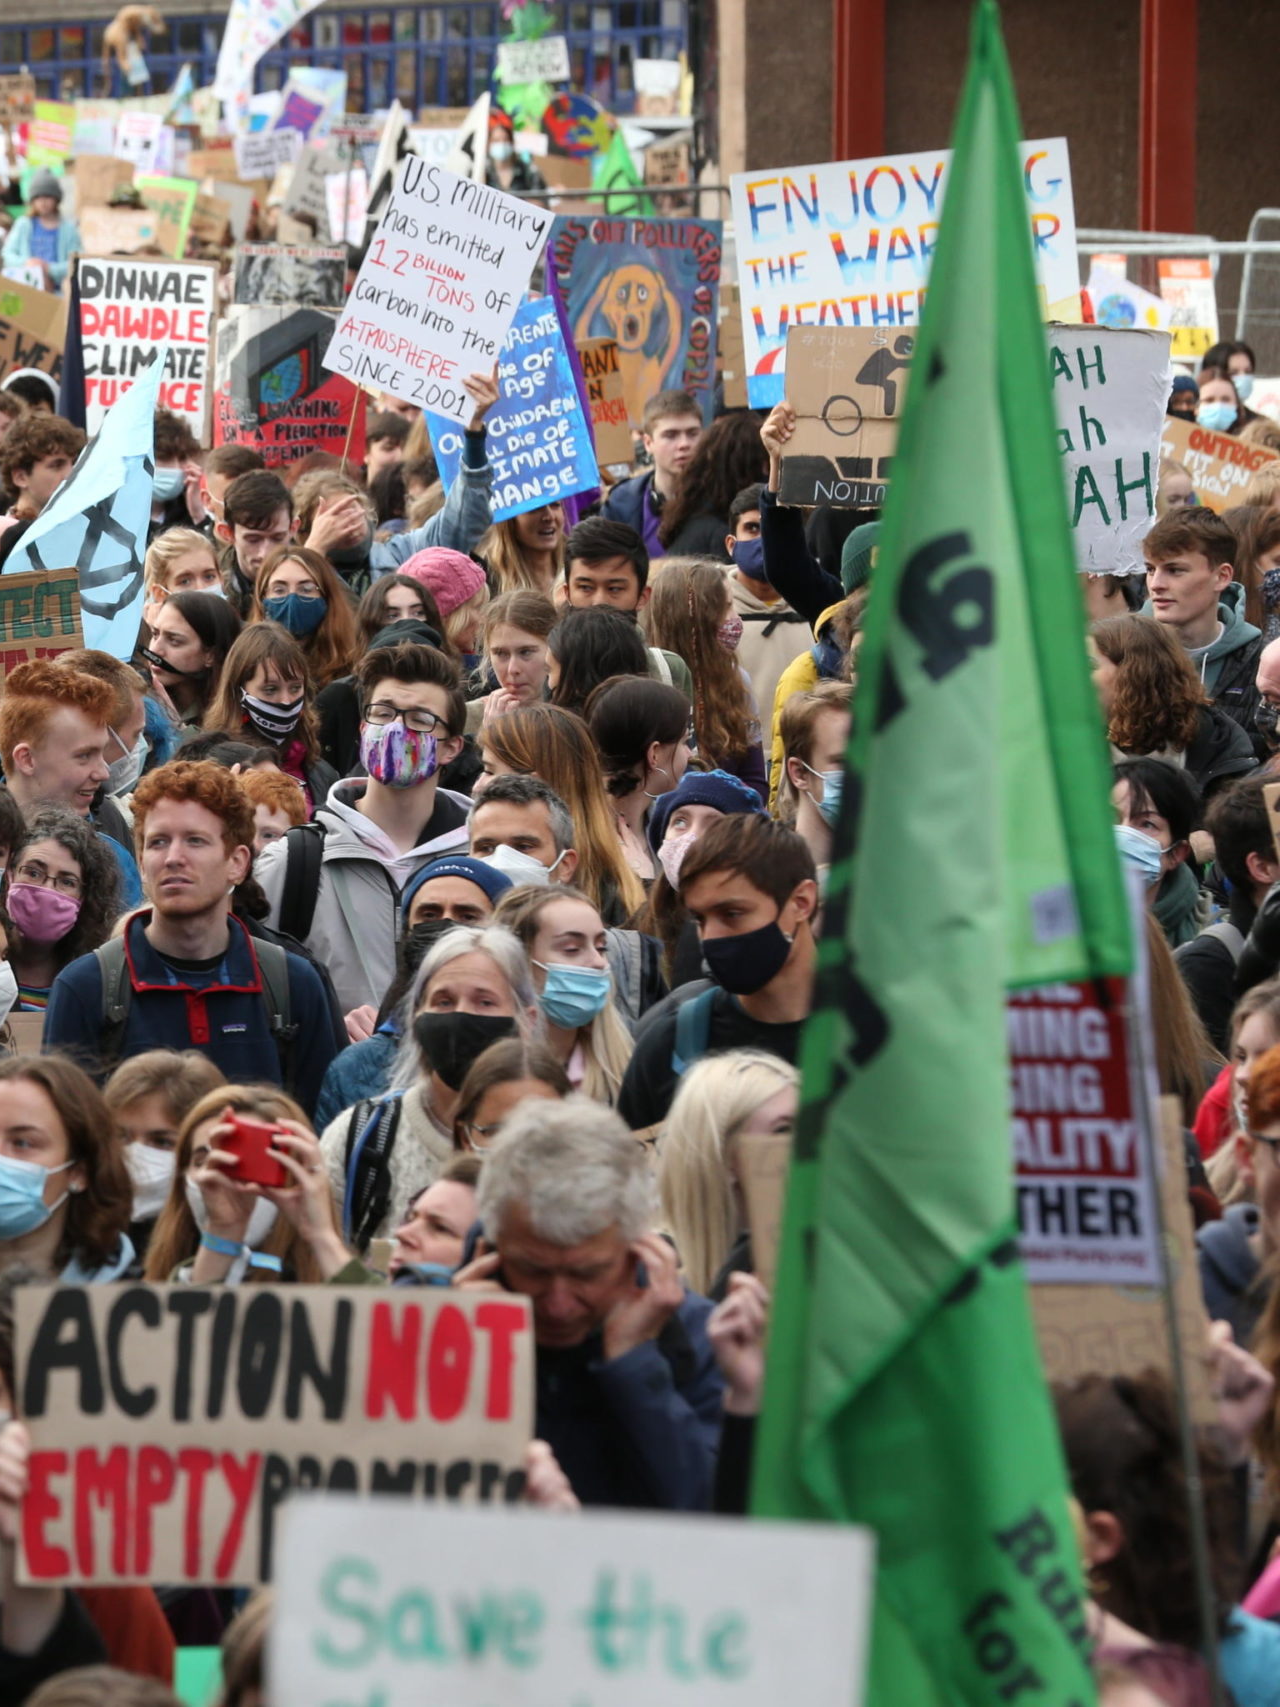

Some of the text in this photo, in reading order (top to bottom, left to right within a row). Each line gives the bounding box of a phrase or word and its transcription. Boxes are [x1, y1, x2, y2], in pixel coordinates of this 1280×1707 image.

[451, 179, 546, 251] military
[745, 151, 1063, 243] ENJOYG
[382, 196, 505, 269] has emitted
[80, 265, 207, 304] DINNAE
[413, 254, 466, 281] BILLION
[745, 251, 810, 290] THE
[426, 275, 475, 313] TONS
[80, 303, 207, 343] DAWDLE
[421, 308, 454, 333] into
[463, 328, 495, 356] the
[340, 316, 458, 380] ATMOSPHERE
[579, 342, 619, 379] ANT
[1050, 345, 1107, 390] AH
[84, 377, 203, 412] JUICE
[411, 378, 468, 419] 2001
[814, 480, 887, 503] UTION
[1072, 451, 1155, 528] AH
[1011, 1117, 1138, 1172] ALITY
[1016, 1183, 1141, 1238] THER
[24, 1287, 529, 1423] ACTION NOT
[24, 1444, 265, 1580] EMPTY
[313, 1553, 753, 1682] Save the
